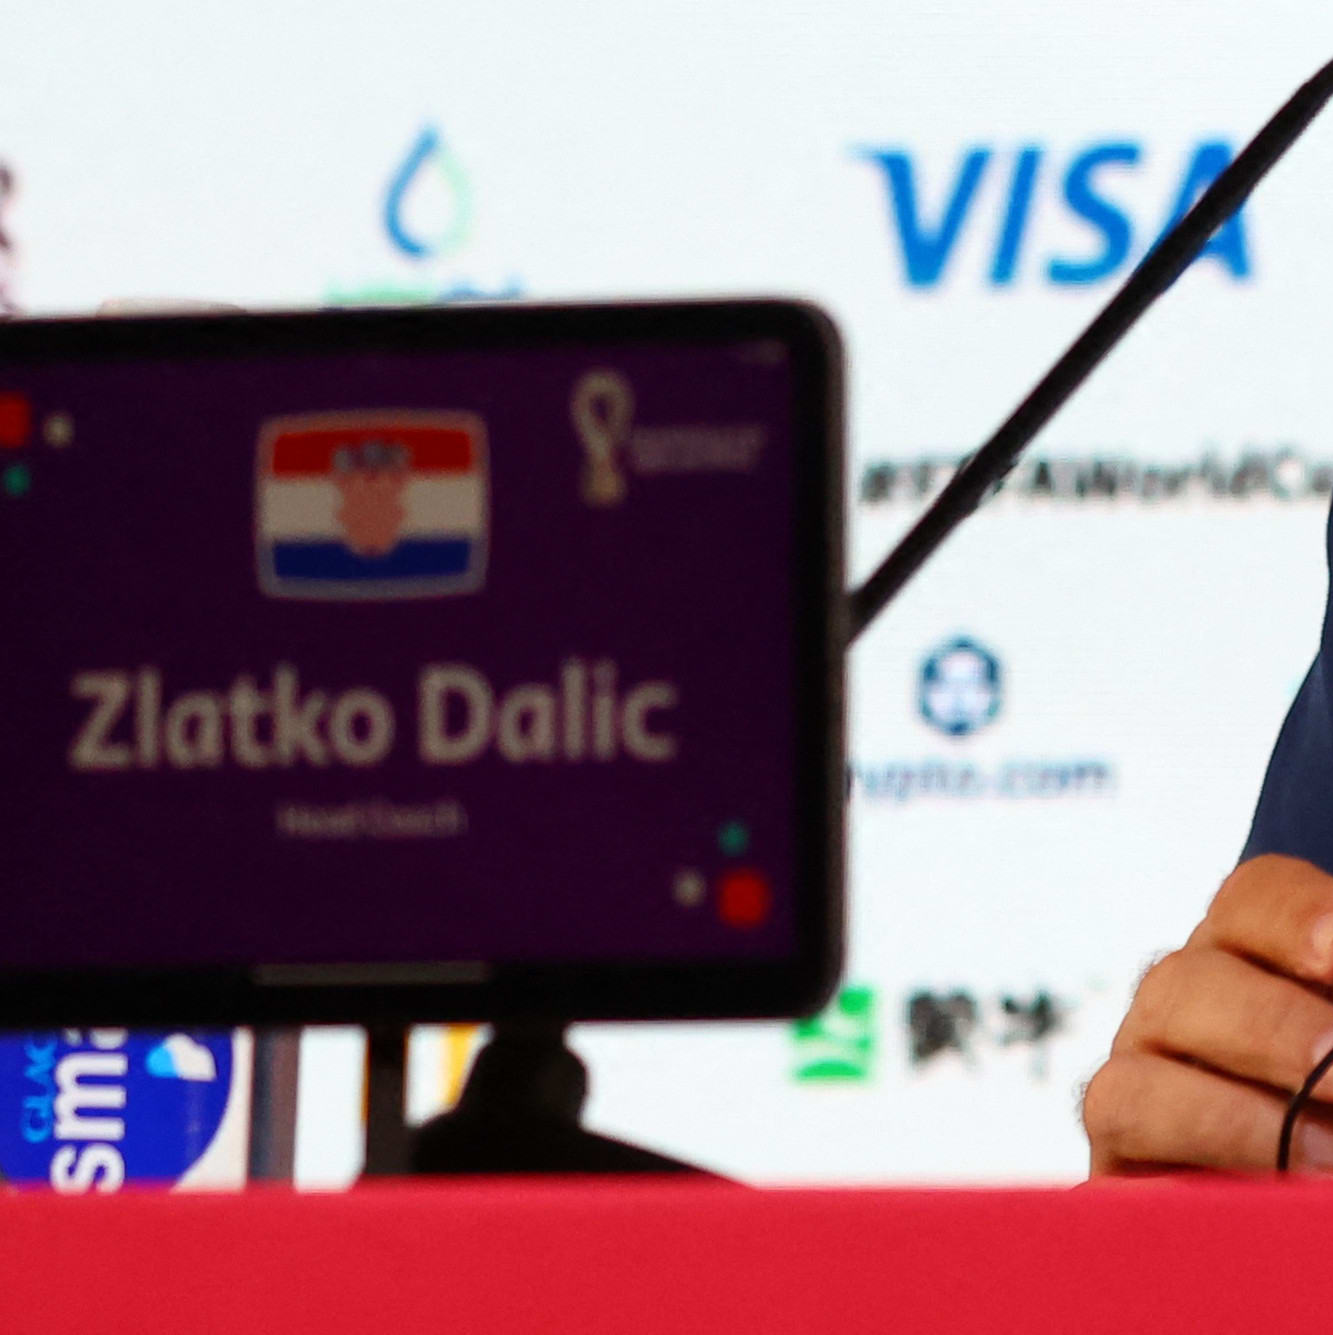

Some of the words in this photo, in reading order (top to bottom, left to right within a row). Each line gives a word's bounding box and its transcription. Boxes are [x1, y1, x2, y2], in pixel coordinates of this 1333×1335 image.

[856, 138, 1256, 290] VISA
[71, 666, 394, 770] Zlatko
[418, 659, 677, 764] Dalic
